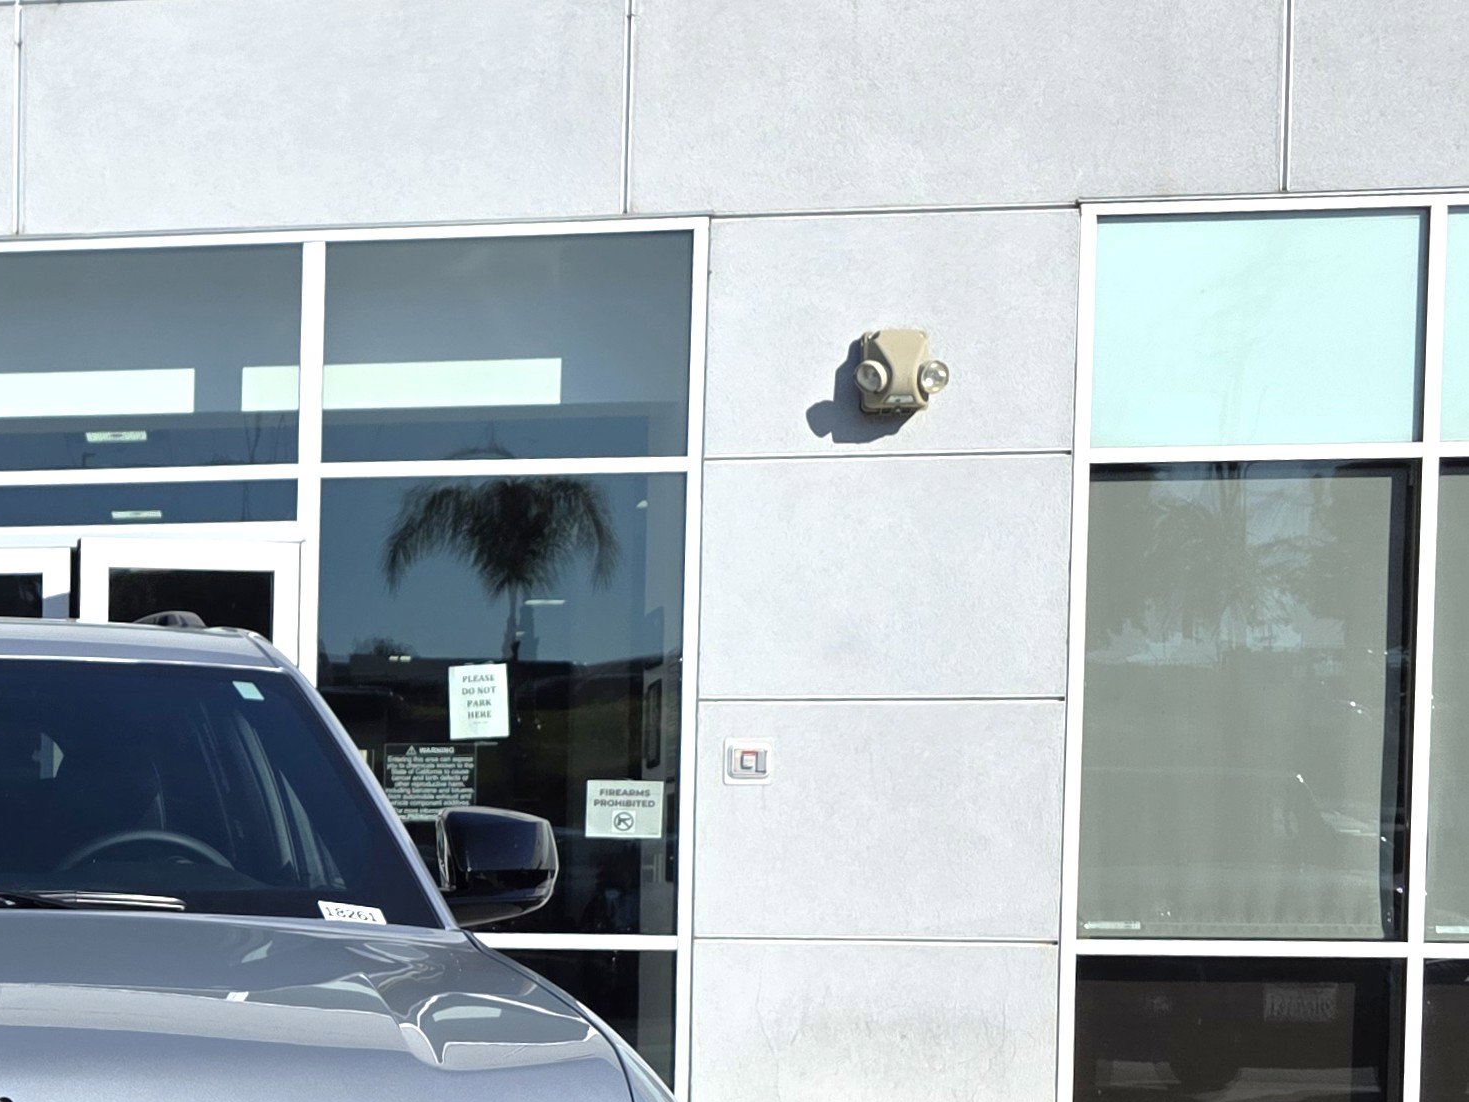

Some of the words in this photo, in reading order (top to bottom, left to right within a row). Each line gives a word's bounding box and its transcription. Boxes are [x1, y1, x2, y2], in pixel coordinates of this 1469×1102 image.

[462, 673, 495, 683] PLEASE
[461, 687, 475, 695] DO
[477, 686, 497, 694] NOT
[467, 699, 492, 707] PARK
[467, 710, 492, 719] HERE
[419, 746, 455, 754] WARNING
[599, 788, 651, 797] FIREARMS
[593, 799, 656, 808] PROHIBITED
[325, 906, 377, 922] 18261
